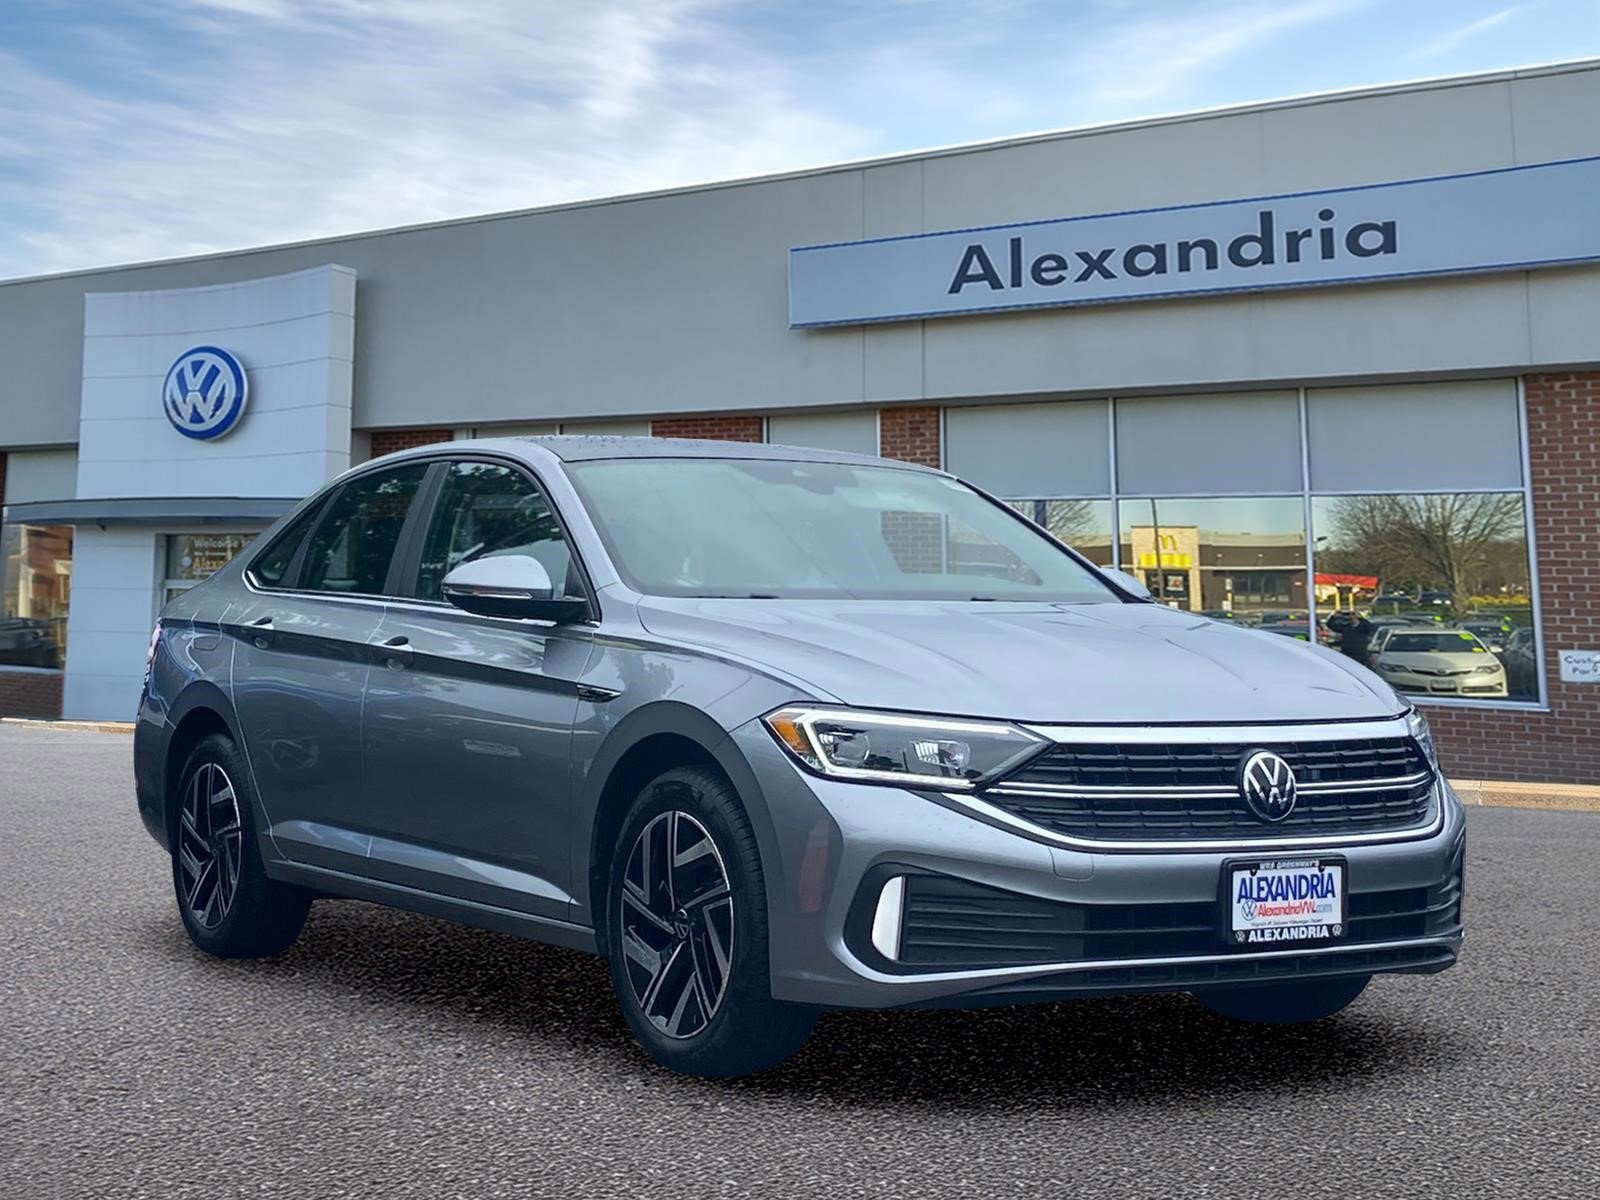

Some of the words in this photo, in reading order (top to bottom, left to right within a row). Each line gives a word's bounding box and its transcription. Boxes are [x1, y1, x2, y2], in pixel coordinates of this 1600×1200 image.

[946, 207, 1398, 294] Alexandria
[162, 346, 247, 440] VW
[1237, 872, 1336, 903] ALEXANDRIA
[1248, 926, 1329, 942] ALEXANDRIA
